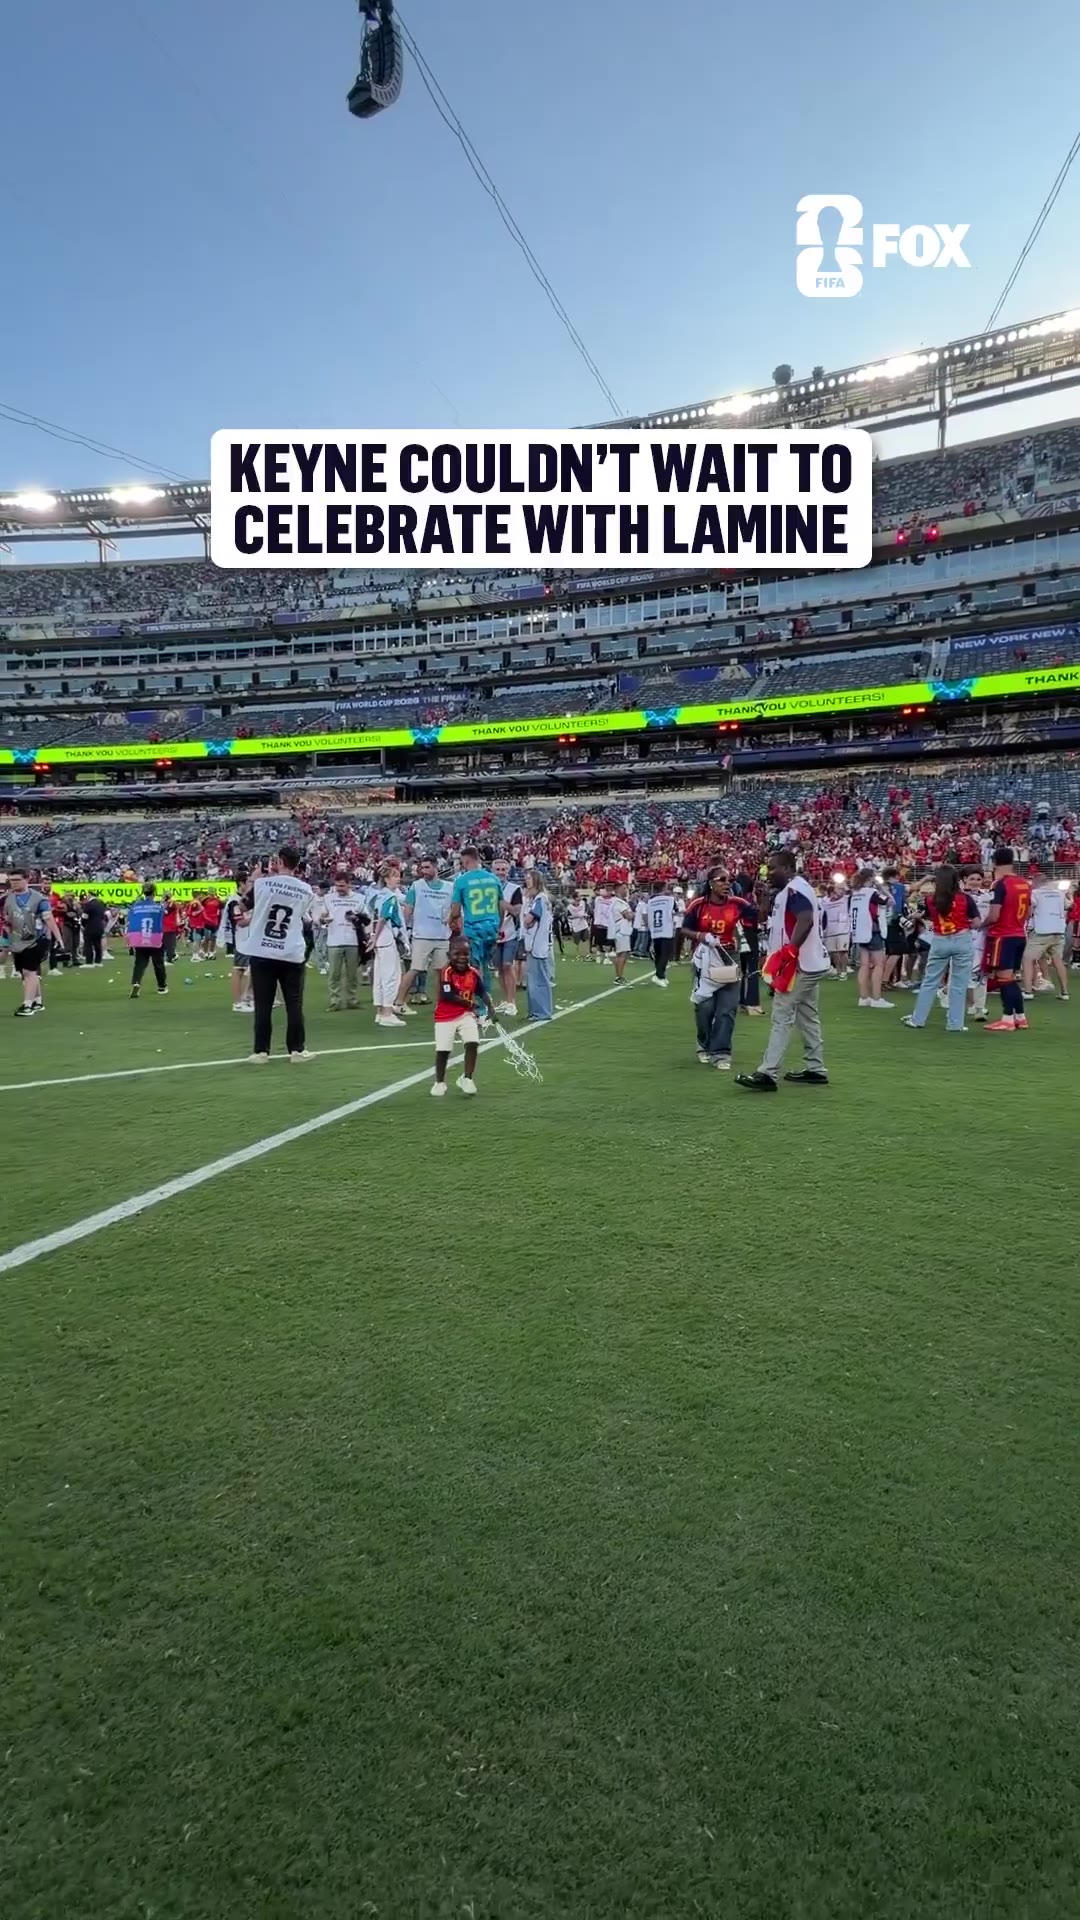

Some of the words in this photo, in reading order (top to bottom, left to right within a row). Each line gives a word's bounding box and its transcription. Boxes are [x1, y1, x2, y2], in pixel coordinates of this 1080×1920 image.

[576, 581, 591, 590] FIFA
[592, 578, 616, 588] WORLD
[954, 639, 986, 650] NEW
[988, 632, 1029, 645] YORK
[1032, 628, 1066, 640] NEW
[1024, 672, 1080, 685] THANK
[336, 700, 352, 710] FIFA
[352, 699, 378, 710] WORLD
[394, 697, 420, 706] 2026
[422, 696, 439, 704] THE
[716, 706, 757, 716] THANK
[761, 702, 786, 712] YOU
[788, 692, 885, 708] VOLUNTEERS!
[472, 726, 506, 736] THANK
[508, 724, 530, 732] YOU
[530, 718, 609, 732] VOLUNTEERS!
[313, 736, 381, 746] VOLUNTEERS!
[110, 888, 132, 898] YOU
[275, 888, 304, 900] FAMILIES
[469, 888, 498, 916] 23
[1016, 893, 1028, 920] 6
[711, 920, 726, 934] 19
[261, 941, 285, 950] 2026
